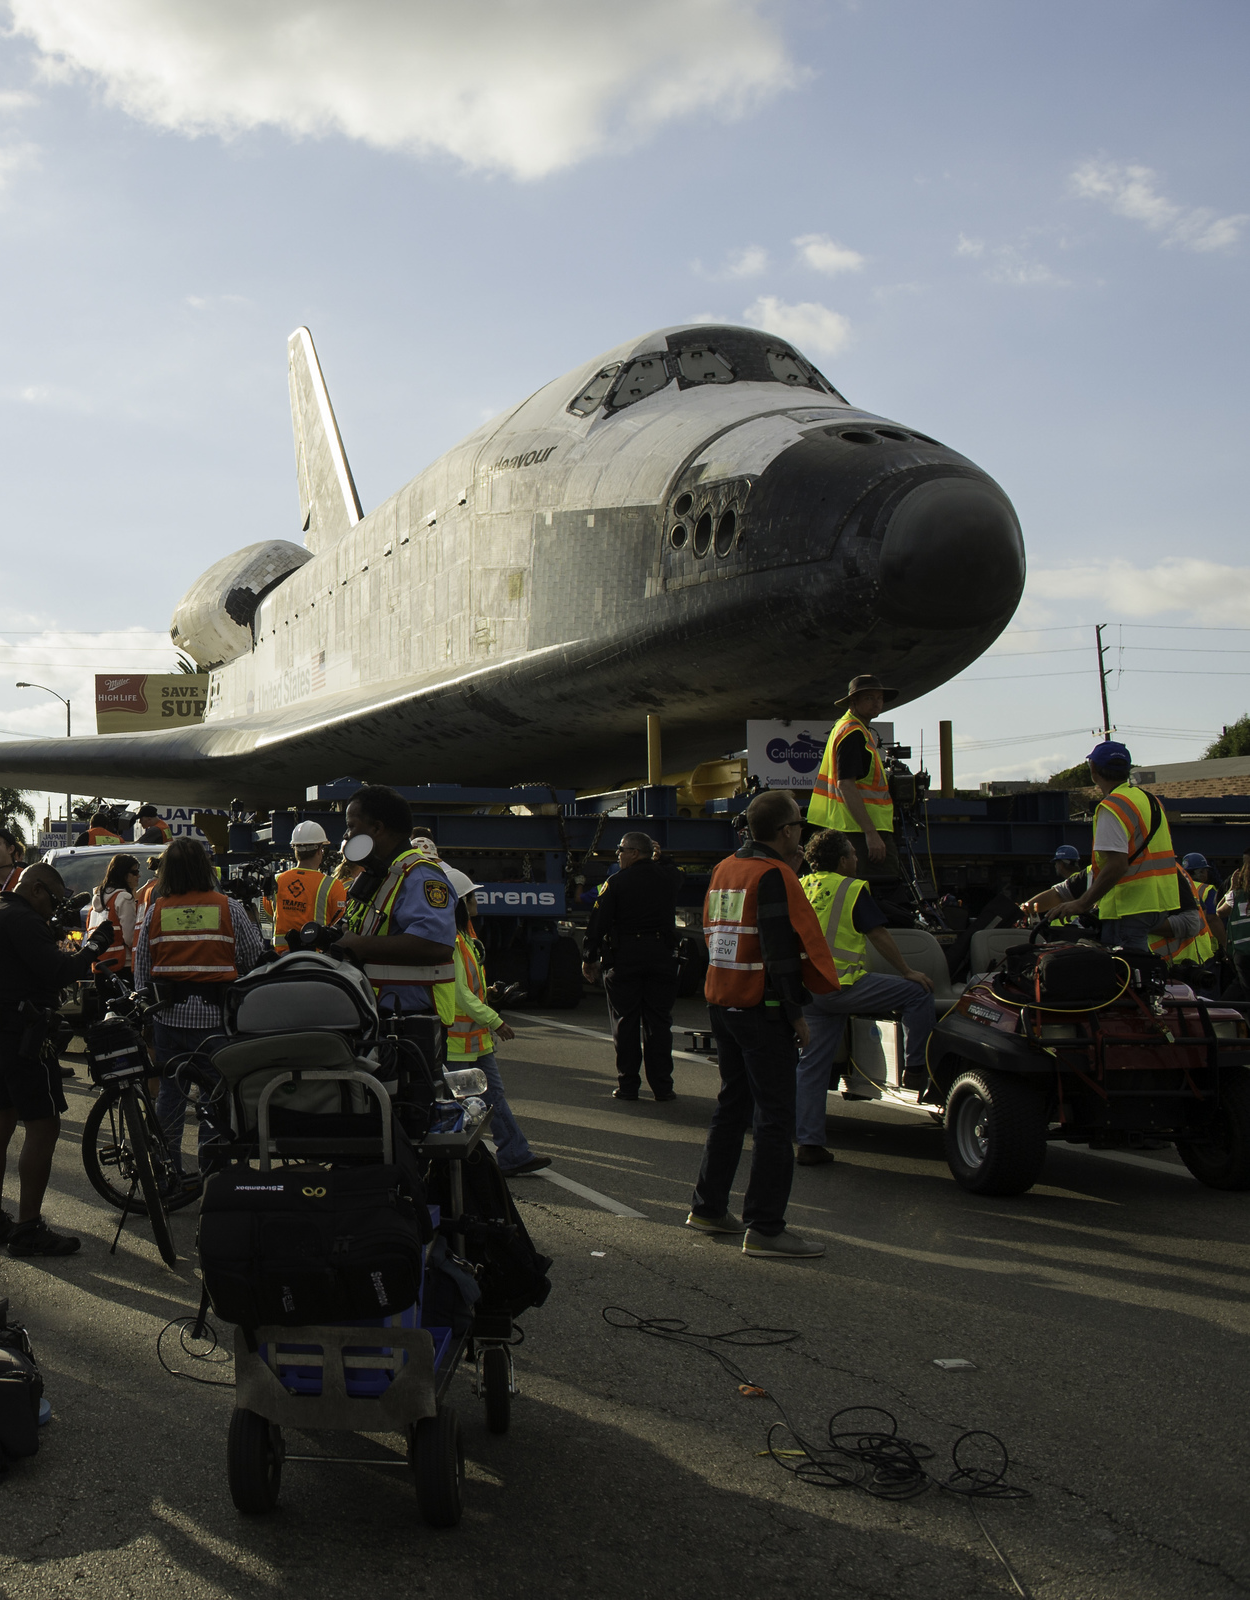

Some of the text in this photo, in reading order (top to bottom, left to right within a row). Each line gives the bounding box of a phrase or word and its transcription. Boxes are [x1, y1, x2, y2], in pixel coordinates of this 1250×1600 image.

[104, 678, 130, 691] Miller
[258, 667, 311, 712] United States
[161, 687, 199, 697] SAVE
[98, 694, 138, 702] HIGH LIFE
[161, 700, 207, 717] SUP
[766, 776, 790, 786] Samuel
[791, 776, 813, 786] Oschin
[170, 824, 206, 837] UTO
[40, 840, 58, 848] AUTO
[474, 891, 556, 906] arens
[282, 899, 307, 909] TRAFFIC
[234, 1184, 278, 1192] Streambox
